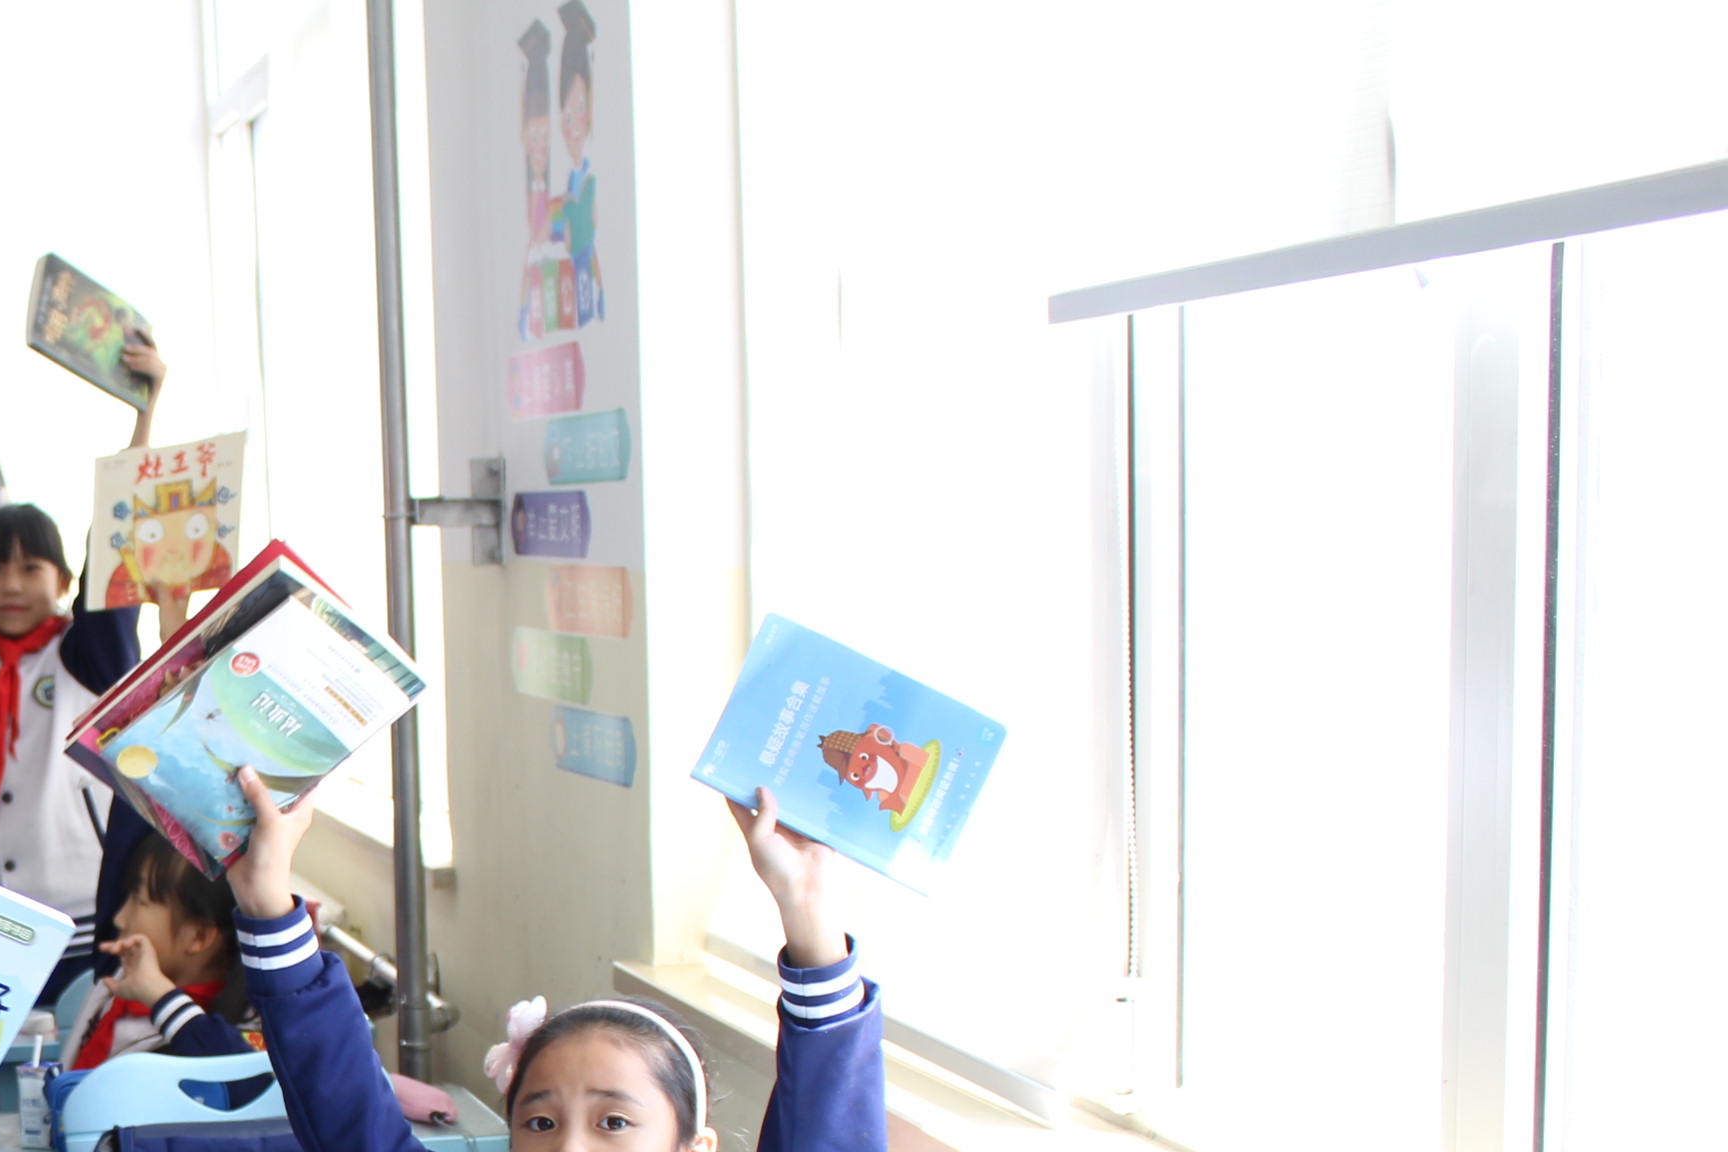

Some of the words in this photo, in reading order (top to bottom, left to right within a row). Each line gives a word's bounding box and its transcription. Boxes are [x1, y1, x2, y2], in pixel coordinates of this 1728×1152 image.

[134, 442, 217, 485] 灶王爷
[758, 679, 810, 769] 悬疑故事合集
